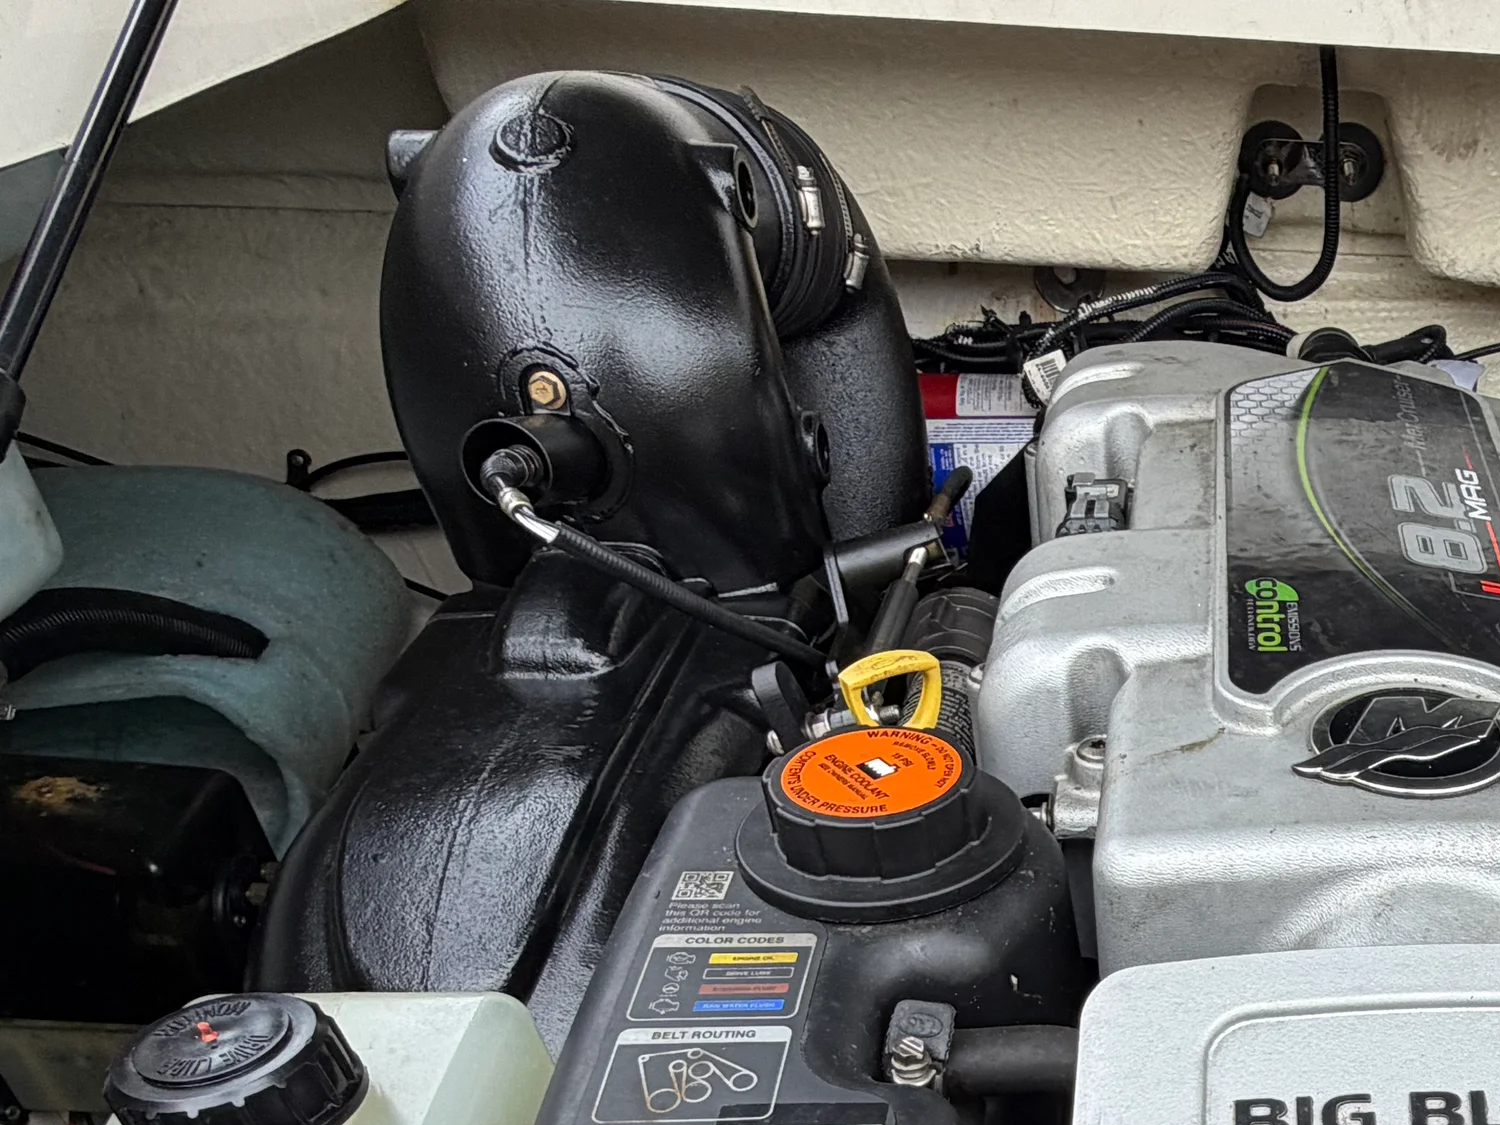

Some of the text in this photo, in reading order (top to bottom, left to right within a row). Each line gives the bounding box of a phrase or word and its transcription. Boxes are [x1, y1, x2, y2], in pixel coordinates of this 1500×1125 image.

[1454, 468, 1492, 522] MAG
[1387, 474, 1488, 575] 8.2
[1255, 578, 1288, 652] control
[1286, 602, 1302, 651] EMISSIONS
[867, 730, 932, 745] WARNING
[787, 751, 888, 814] CONTENTS UNDER PRESSURE
[824, 753, 890, 800] ENGINE COOLANT
[651, 1030, 756, 1040] BELT ROUTING
